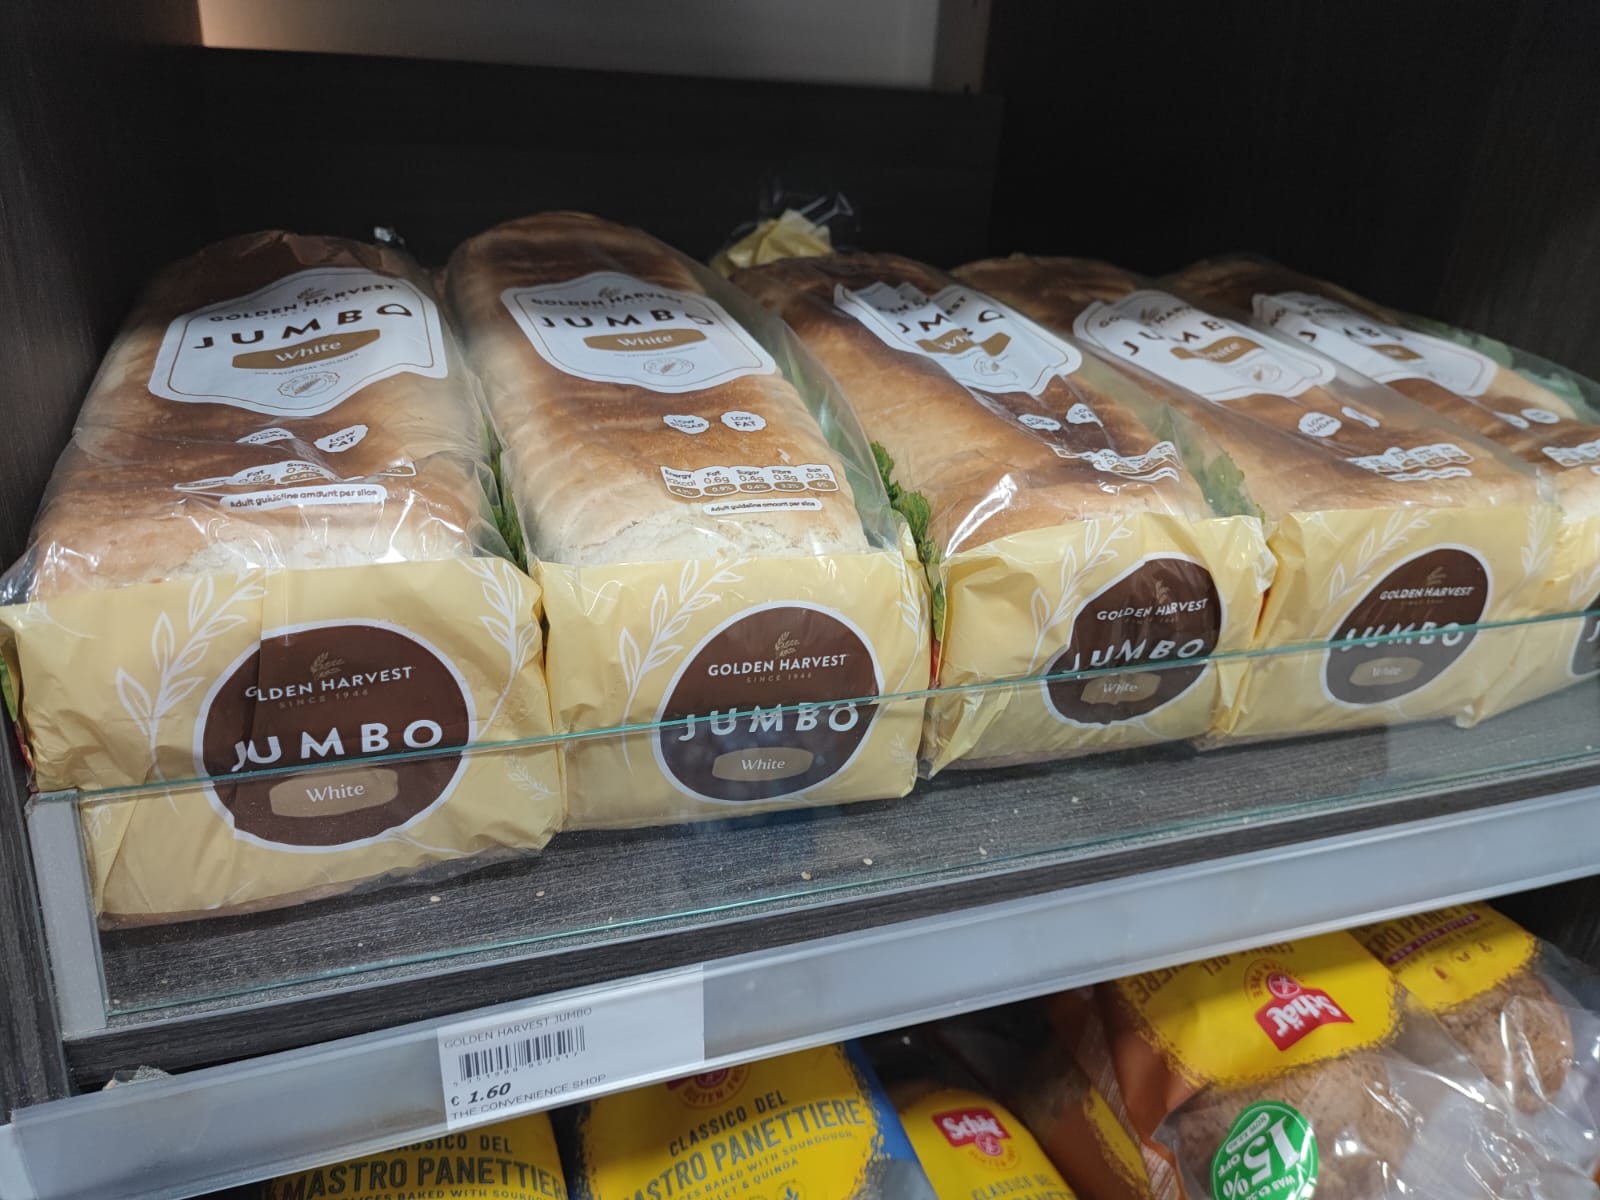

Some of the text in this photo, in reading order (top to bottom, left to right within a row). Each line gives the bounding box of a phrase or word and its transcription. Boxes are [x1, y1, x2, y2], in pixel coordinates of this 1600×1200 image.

[209, 303, 297, 322] GOLDEN
[305, 284, 398, 307] HARVEST
[193, 303, 413, 349] JUMBO
[541, 308, 715, 328] JUMBO
[616, 333, 674, 347] White
[275, 341, 343, 363] White
[734, 420, 757, 428] FAT
[328, 436, 356, 450] FAT
[329, 430, 356, 444] LOW
[703, 476, 730, 485] 0.6g
[706, 470, 722, 478] Fat
[230, 498, 254, 508] Adult
[299, 489, 339, 500] amount
[339, 489, 355, 499] per
[356, 487, 378, 498] slice
[1379, 585, 1475, 600] GOLDEN HARVEST
[1096, 605, 1154, 622] GOLDEN
[1155, 598, 1209, 617] HARVEST
[1341, 621, 1465, 652] JUMBO
[707, 653, 848, 677] GOLDEN HARVEST
[1062, 638, 1206, 674] JUMBO
[244, 665, 414, 702] GLDEN HARVEST
[745, 674, 783, 684] SINCE
[1102, 682, 1139, 695] White
[279, 695, 327, 710] SINCE
[678, 701, 860, 742] JUMBO
[230, 719, 443, 773] JUMBO
[741, 758, 786, 772] White
[305, 782, 366, 803] White
[1265, 994, 1343, 1038] Schär
[444, 1007, 593, 1049] GOLDEN HARVEST JUMBO
[451, 1081, 512, 1107] € 1.60
[451, 1073, 607, 1121] THE CONVENIENCE SHOP
[669, 1089, 789, 1158] CLASSICO DEL
[479, 1134, 513, 1154] DEL
[710, 1097, 865, 1173] PANETTIERE
[747, 1153, 779, 1173] WITH
[1217, 1115, 1302, 1200] 15% OFF
[417, 1155, 569, 1200] PANETTIER
[753, 1157, 799, 1185] QUINOA
[451, 1188, 488, 1198] WITH
[1271, 1174, 1296, 1191] WAS
